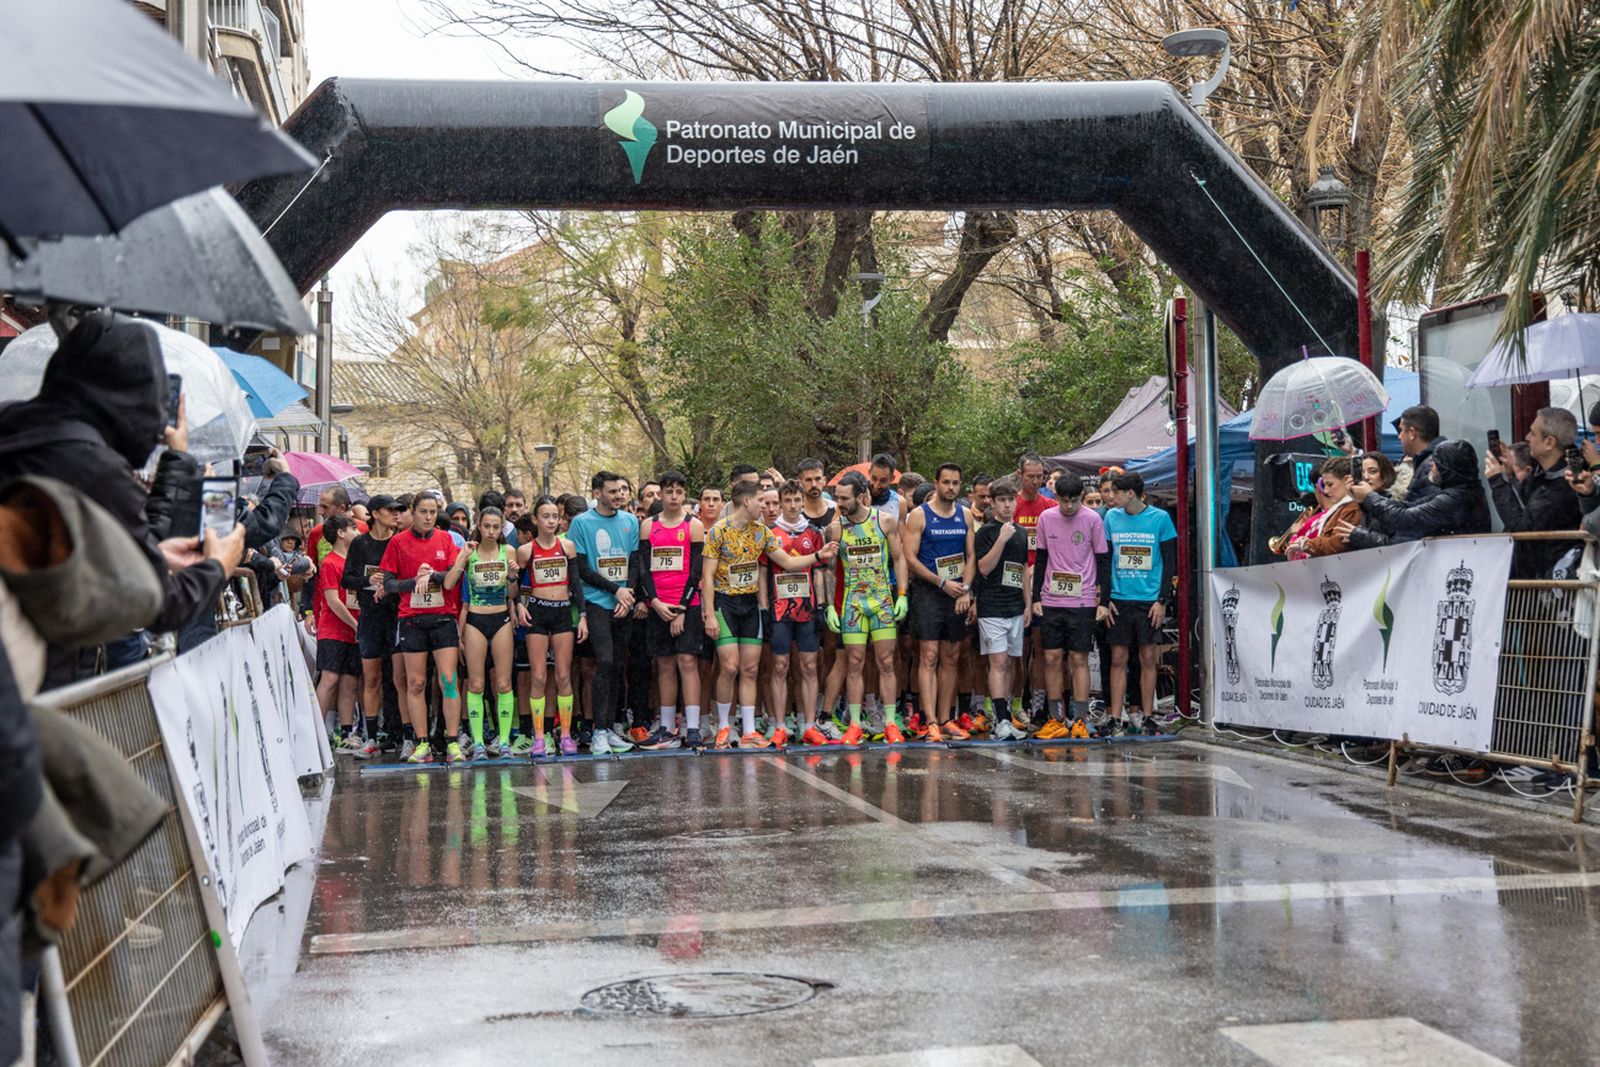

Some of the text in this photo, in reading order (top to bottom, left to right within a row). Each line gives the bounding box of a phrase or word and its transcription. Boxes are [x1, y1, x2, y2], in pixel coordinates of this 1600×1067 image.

[666, 120, 916, 145] Patronato Municipal de
[666, 144, 859, 167] Deportes de Jaén
[854, 537, 872, 546] 1153
[659, 556, 673, 566] 715
[1127, 555, 1143, 565] 796
[483, 571, 500, 581] 986
[543, 568, 560, 578] 304
[607, 567, 622, 577] 671
[738, 572, 753, 582] 725
[787, 583, 799, 593] 60
[1057, 581, 1073, 591] 579
[423, 593, 432, 603] 12
[1324, 697, 1331, 708] DE
[1418, 701, 1478, 720] CIUDAD DE JAÉN
